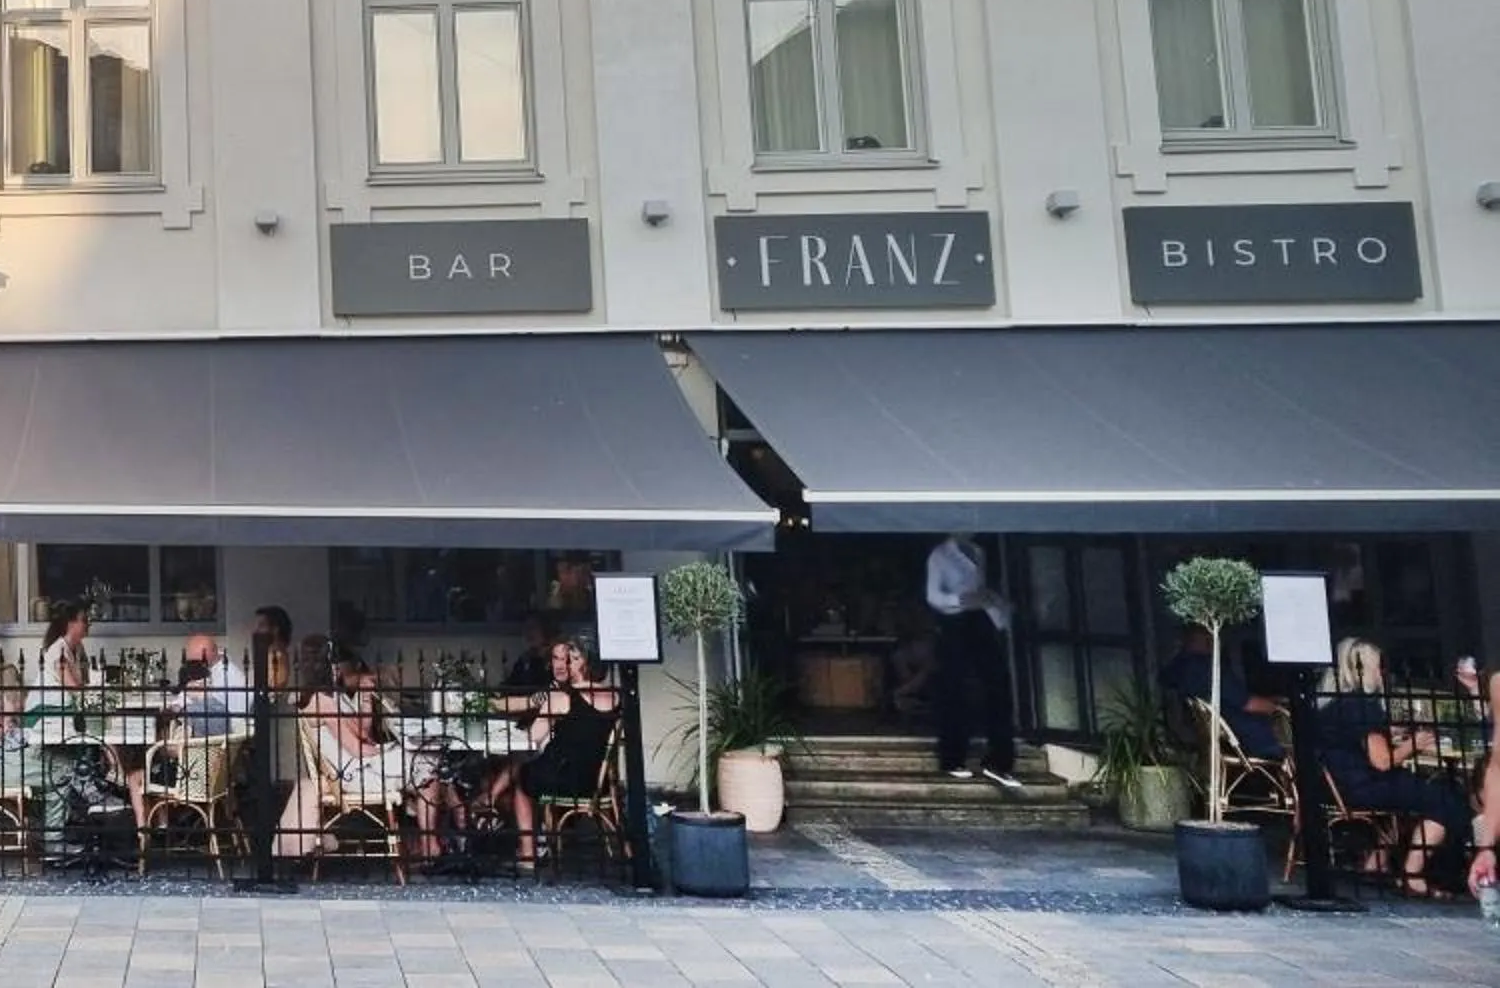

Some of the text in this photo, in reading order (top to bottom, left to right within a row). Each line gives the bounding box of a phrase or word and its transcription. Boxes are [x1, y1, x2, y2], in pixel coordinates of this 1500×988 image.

[408, 253, 512, 280] BAR
[758, 232, 961, 287] FRANZ
[1160, 236, 1388, 267] BISTRO
